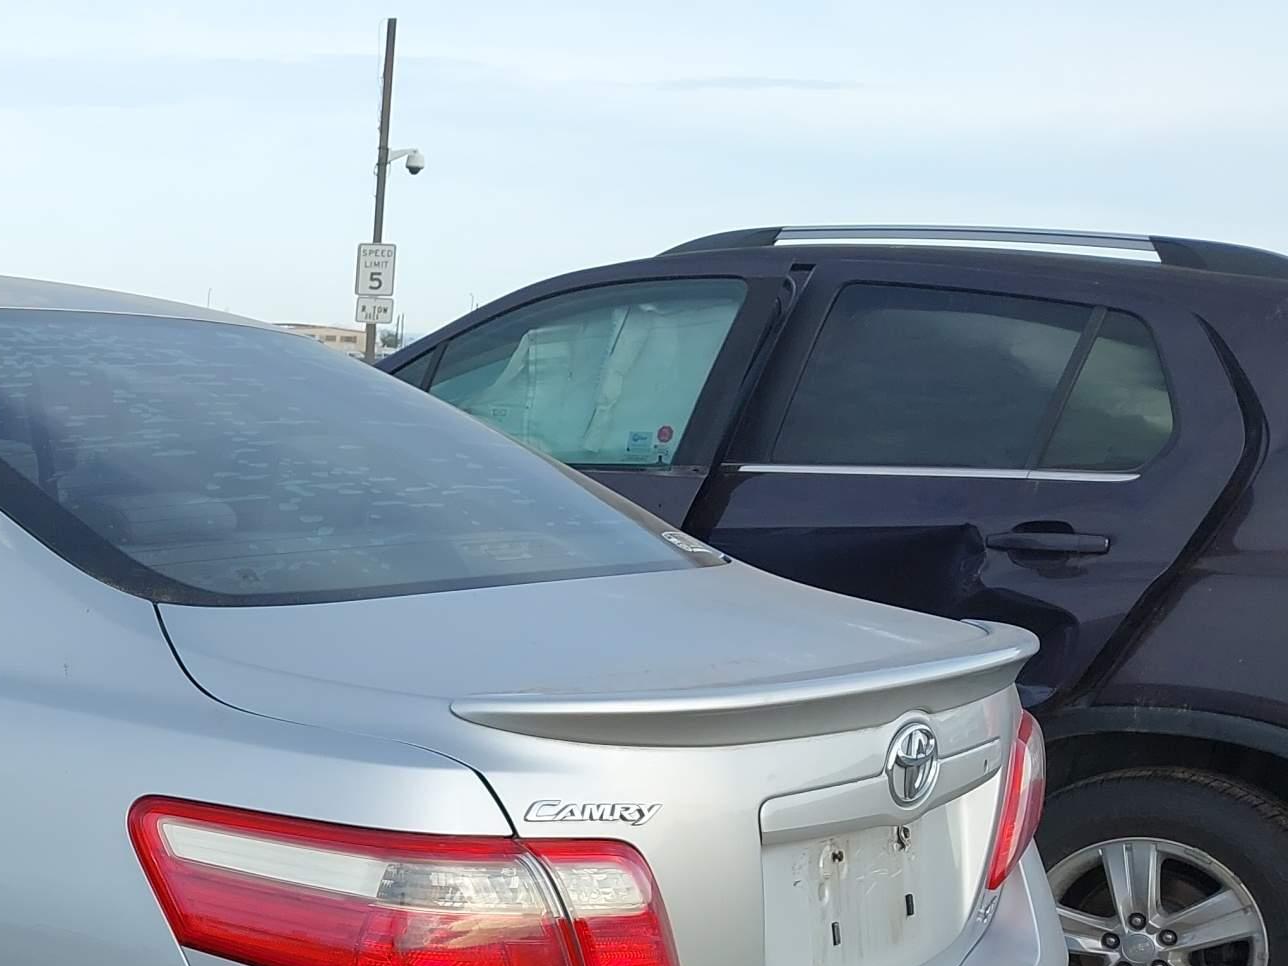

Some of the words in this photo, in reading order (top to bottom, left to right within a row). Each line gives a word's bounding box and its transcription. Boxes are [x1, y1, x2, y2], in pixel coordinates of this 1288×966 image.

[362, 249, 393, 257] SPEED
[364, 261, 389, 269] LIMIT
[369, 272, 383, 290] 5
[523, 799, 664, 827] CAMRY
